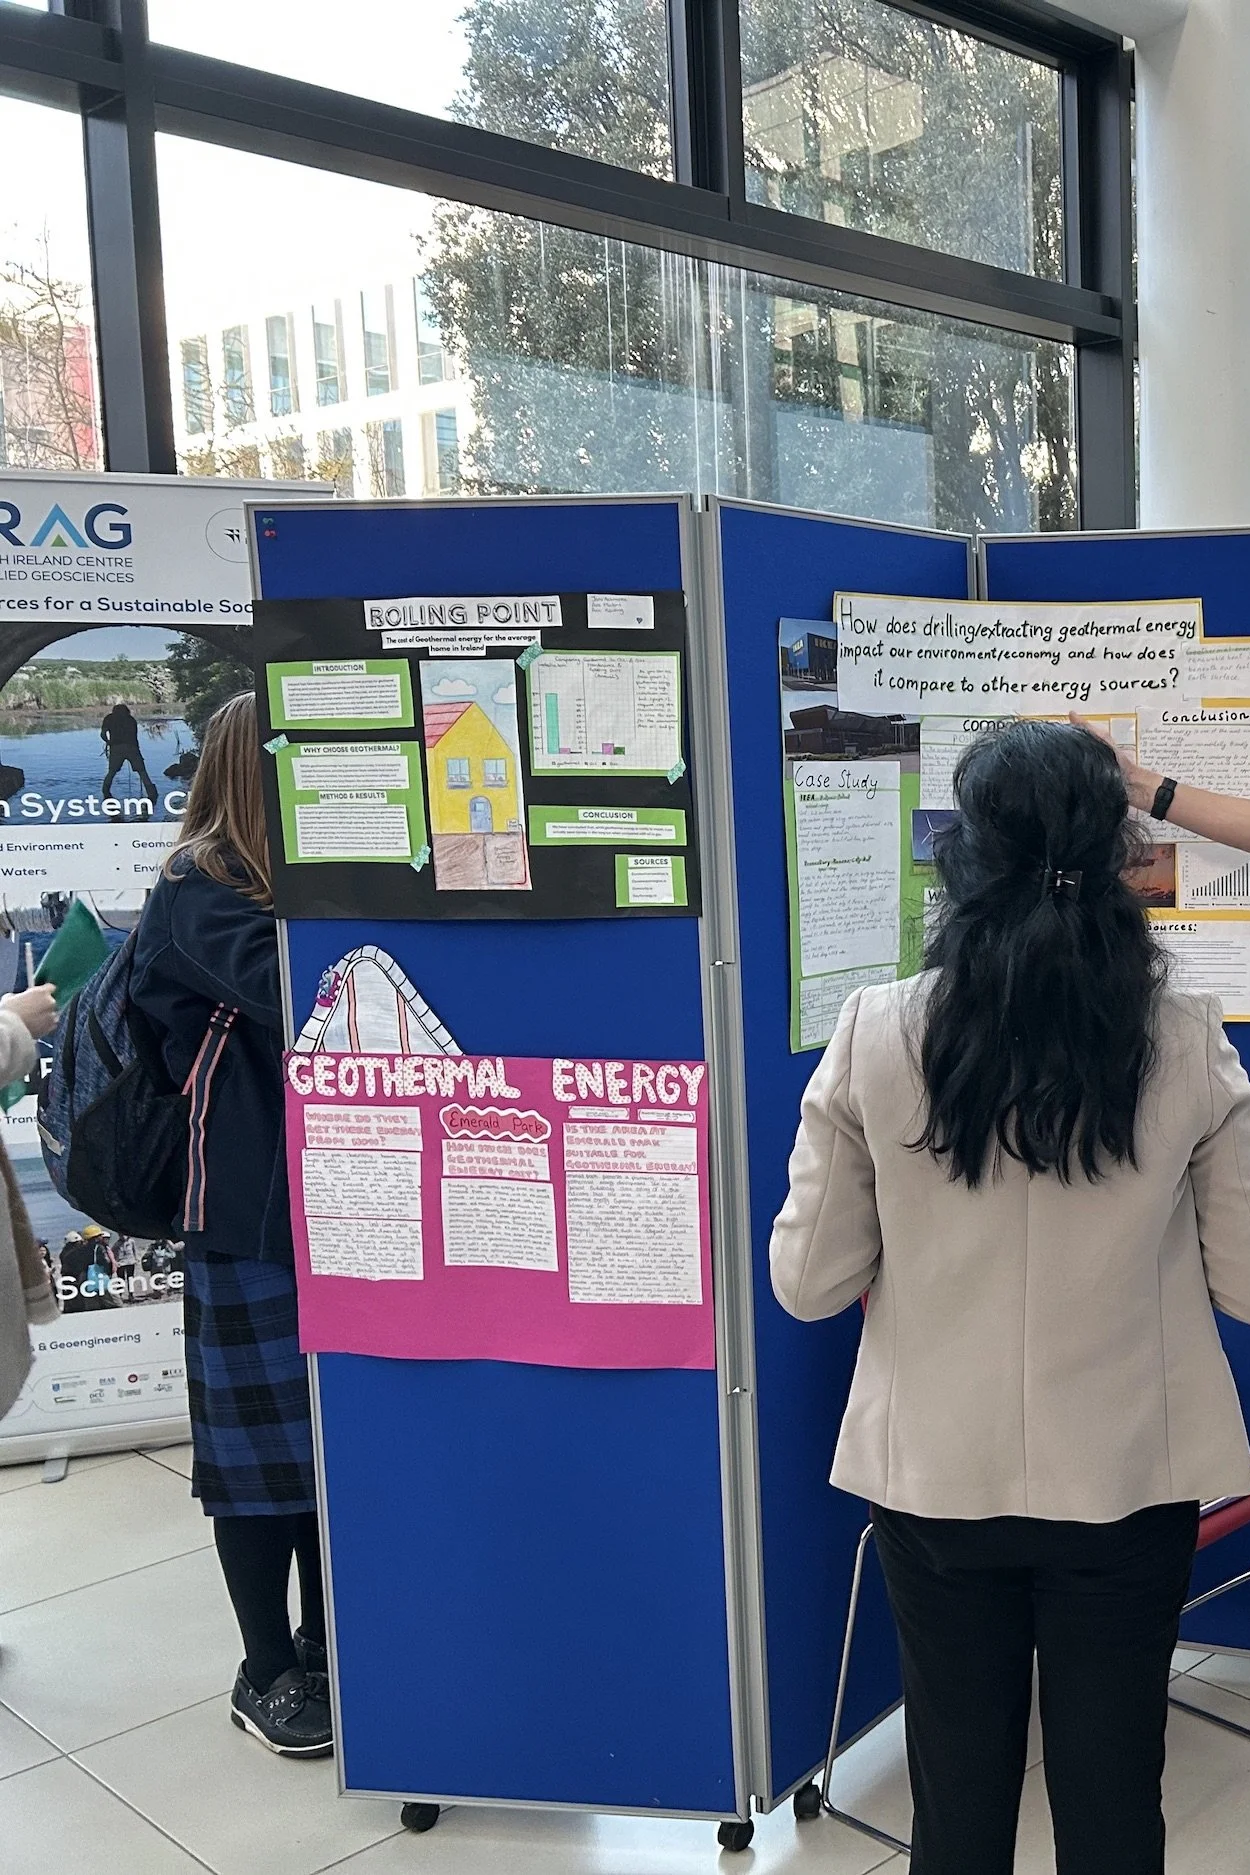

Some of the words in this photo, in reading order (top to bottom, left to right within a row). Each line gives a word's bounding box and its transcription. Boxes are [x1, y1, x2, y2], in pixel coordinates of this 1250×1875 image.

[13, 555, 73, 566] IRELAND
[76, 557, 133, 568] CENTRE
[31, 571, 135, 583] GEOSCIENCES
[44, 596, 75, 611] for
[80, 600, 92, 611] a
[98, 598, 214, 613] Sustainable
[370, 603, 468, 627] BOILING
[477, 601, 557, 624] POINT
[841, 598, 878, 635] How
[886, 616, 916, 634] does
[923, 612, 1052, 644] drilling/extracting
[1058, 617, 1142, 643] geothermal
[1146, 620, 1196, 639] energy
[458, 636, 482, 645] energy
[508, 634, 537, 643] average
[460, 644, 484, 652] Ireland
[840, 640, 884, 666] impact
[890, 648, 913, 659] our
[917, 646, 1060, 666] environment/economy
[1068, 647, 1096, 660] and
[1103, 646, 1133, 660] how
[1137, 646, 1176, 660] does
[314, 664, 364, 673] INTRODUCTION
[874, 668, 883, 687] it
[888, 676, 956, 700] compare
[961, 677, 974, 692] to
[981, 676, 1028, 693] other
[1032, 680, 1092, 702] energy
[1100, 668, 1179, 692] sources?
[1162, 710, 1250, 724] Conclusion
[350, 745, 400, 753] GEOTHERMAL?
[794, 766, 830, 788] Case
[838, 769, 878, 800] Study
[21, 792, 154, 822] System
[164, 791, 191, 815] C
[582, 811, 633, 819] CONCLUSION
[6, 842, 84, 852] Environment
[132, 840, 176, 849] Geoma
[2, 868, 48, 876] Waters
[287, 1055, 521, 1099] GEOTHERMAL
[552, 1057, 706, 1106] ENERGY
[306, 1112, 351, 1122] WHERE
[354, 1114, 372, 1124] DO
[373, 1114, 408, 1124] THEY
[450, 1110, 500, 1129] Emerald
[512, 1116, 544, 1132] Park
[306, 1124, 331, 1134] GET
[331, 1125, 372, 1135] THERE
[566, 1124, 578, 1134] IS
[580, 1125, 606, 1134] THE
[612, 1126, 648, 1135] AREA
[650, 1127, 668, 1136] AT
[308, 1135, 345, 1145] FROM
[566, 1136, 626, 1146] EMERALD
[446, 1142, 475, 1152] HOW
[518, 1146, 547, 1158] DOES
[566, 1150, 618, 1158] SUITABLE
[624, 1150, 647, 1159] FOR
[446, 1154, 536, 1168] GEOTHERMAL
[566, 1160, 642, 1170] GEOTHERMAL
[448, 1164, 503, 1176] ENERGY
[56, 1270, 184, 1301] Science
[50, 1333, 142, 1350] Geoengineering
